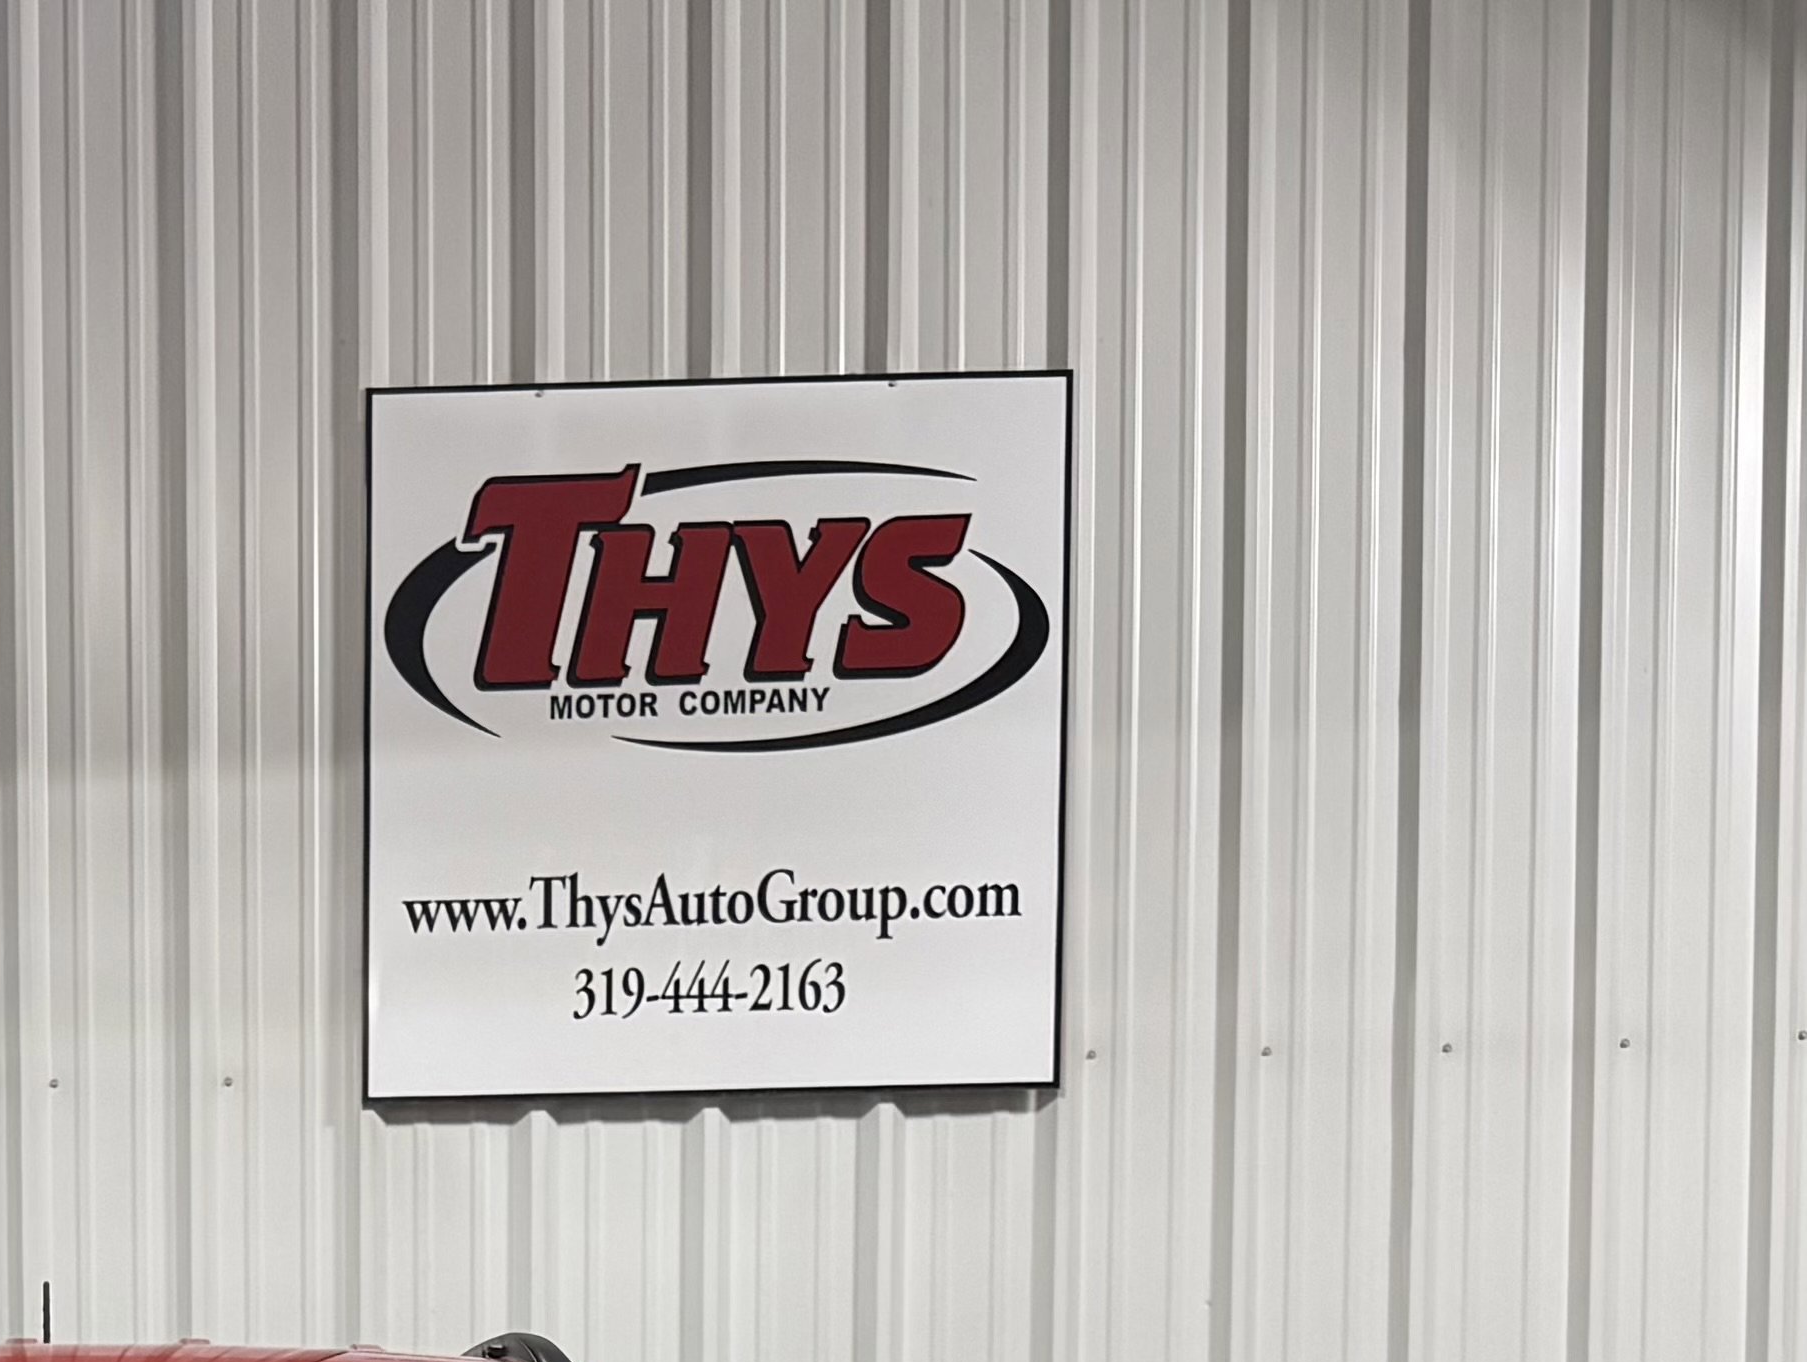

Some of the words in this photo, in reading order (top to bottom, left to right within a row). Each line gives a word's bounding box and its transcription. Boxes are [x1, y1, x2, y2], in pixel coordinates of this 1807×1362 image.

[464, 462, 973, 691] THYS
[548, 691, 660, 721] MOTOR
[677, 686, 831, 717] COMPANY
[402, 868, 1023, 947] www.ThysAutoGroup.com
[572, 958, 847, 1020] 319-444-2163
